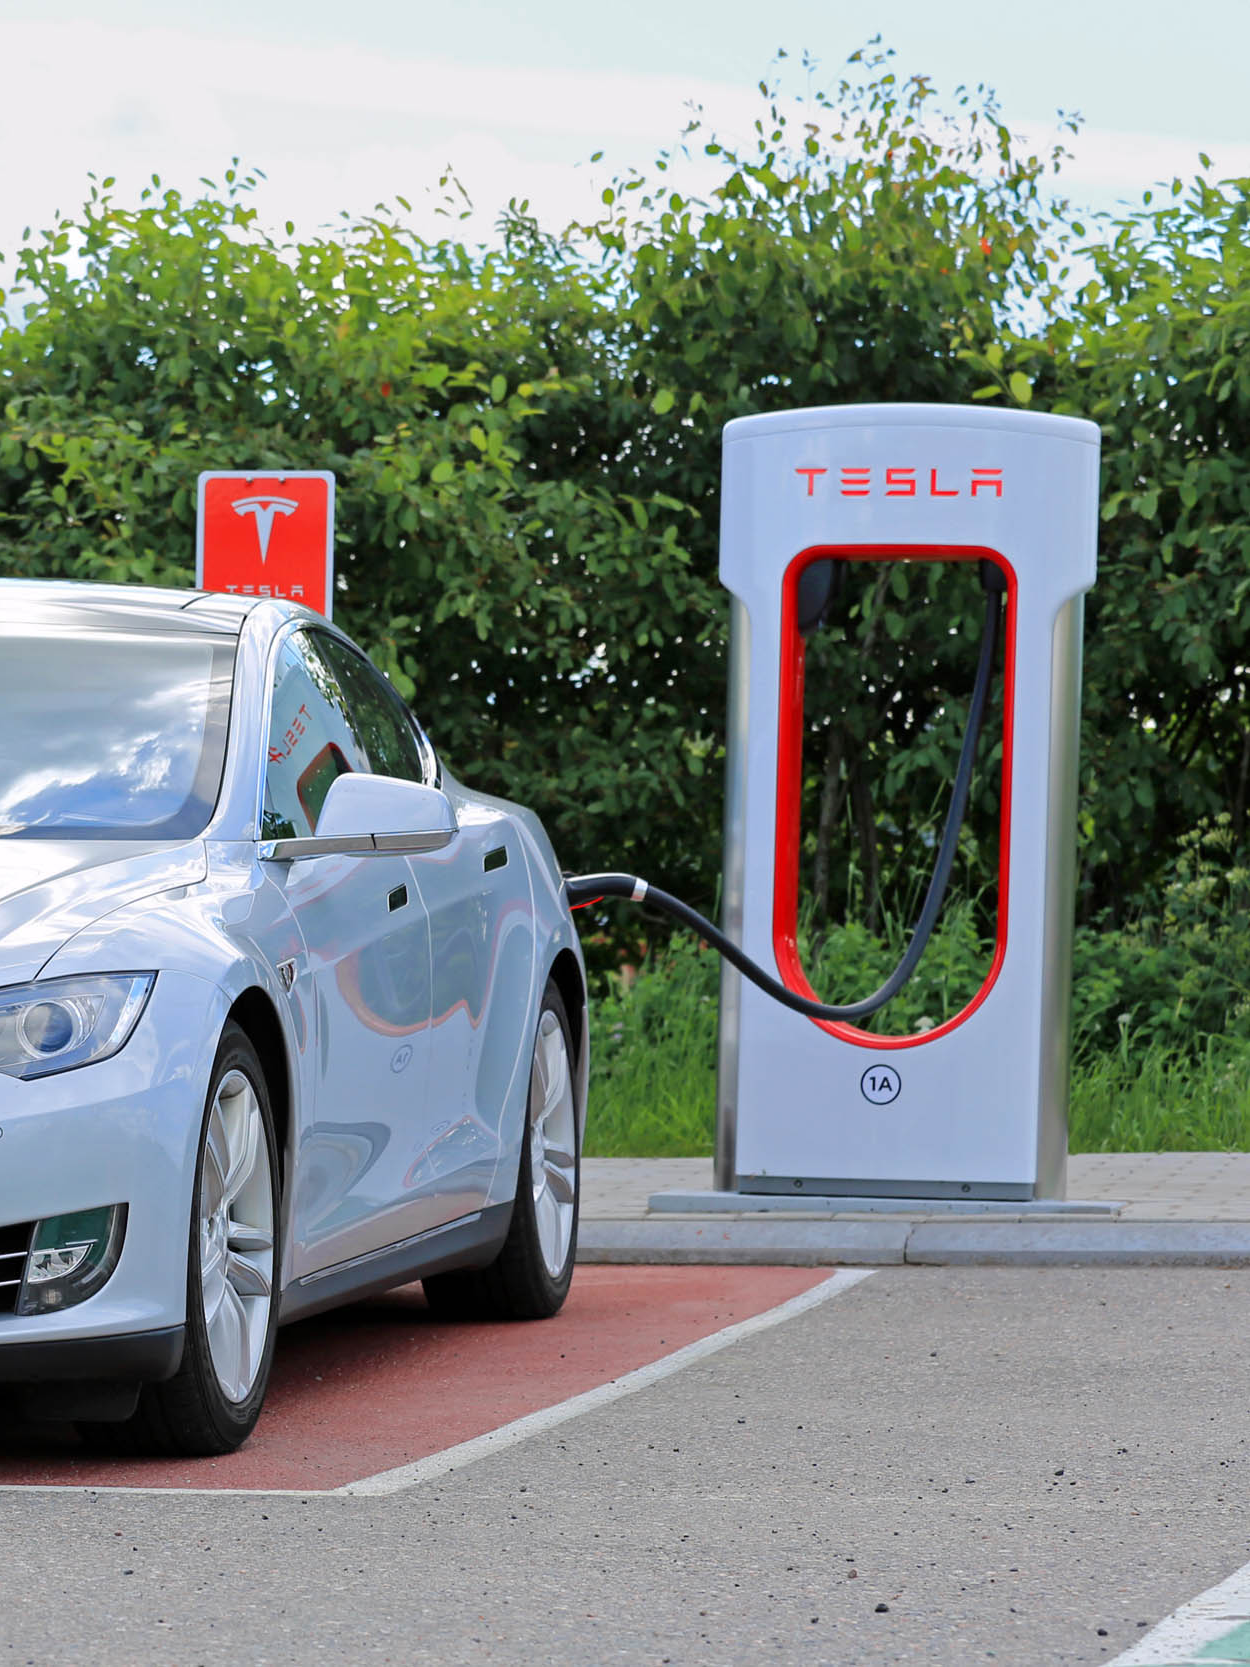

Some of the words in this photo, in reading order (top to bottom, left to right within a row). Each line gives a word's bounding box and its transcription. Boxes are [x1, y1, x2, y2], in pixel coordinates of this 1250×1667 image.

[795, 468, 1003, 497] TESLA
[225, 585, 304, 597] TESLA
[869, 1076, 893, 1092] 1A
